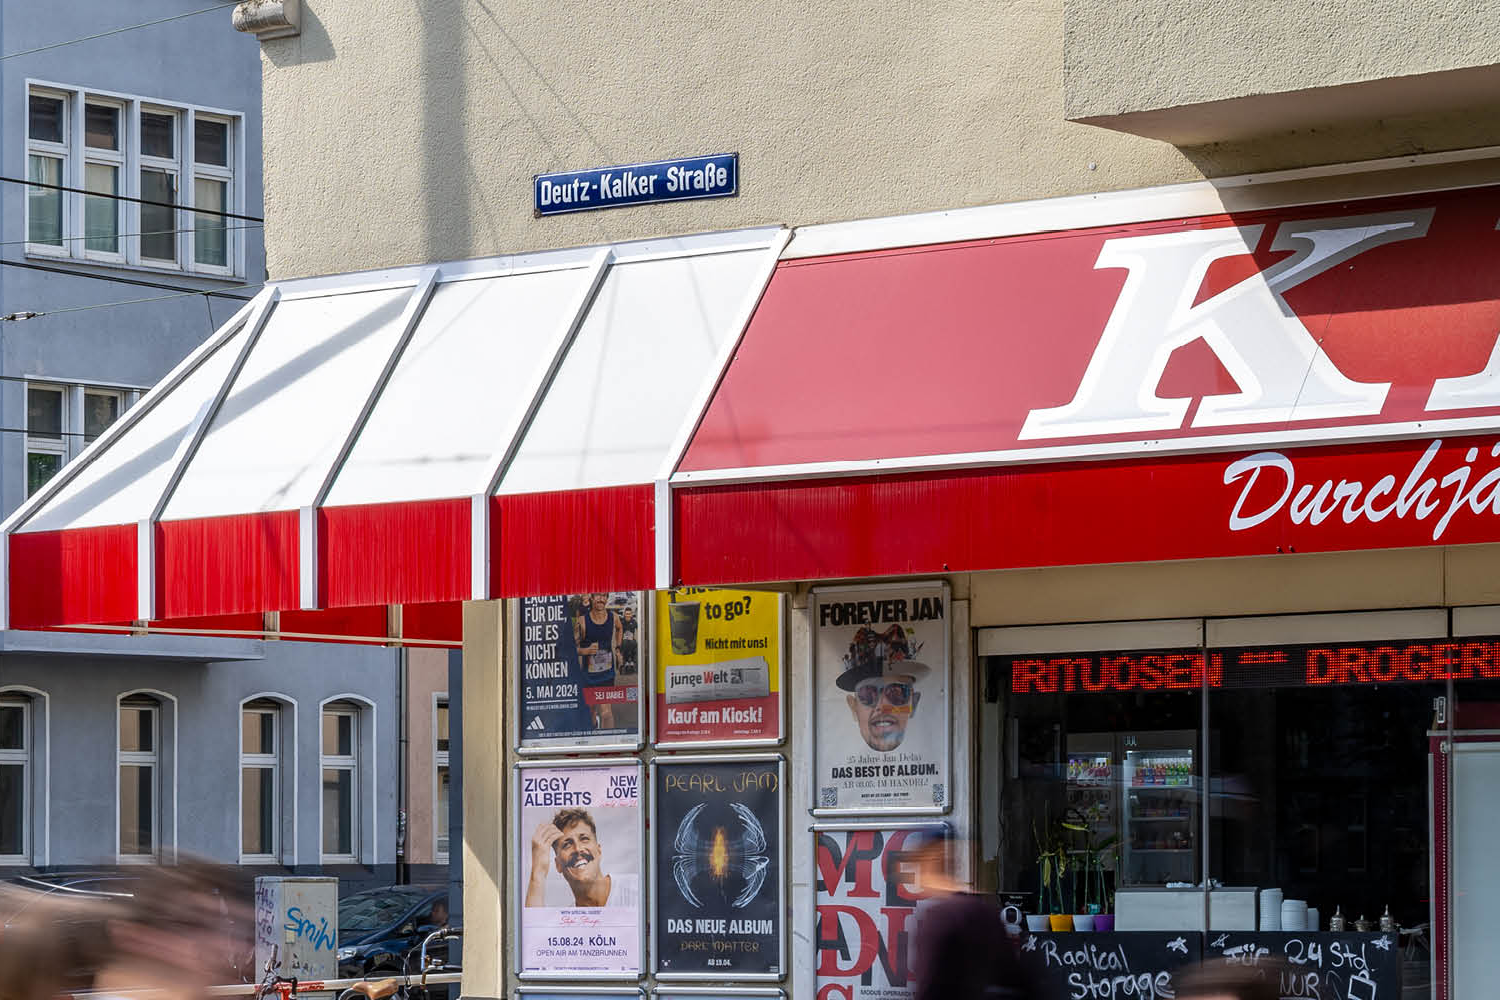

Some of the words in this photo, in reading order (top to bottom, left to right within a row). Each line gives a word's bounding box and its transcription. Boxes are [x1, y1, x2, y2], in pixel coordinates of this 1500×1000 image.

[540, 172, 658, 206] Deutz-Kalker
[666, 162, 728, 193] Straße
[1017, 206, 1500, 441] K
[524, 604, 546, 623] FÜR
[547, 605, 568, 623] DIE,
[705, 602, 721, 620] to
[724, 596, 752, 621] go?
[819, 599, 908, 627] FOREVER
[909, 597, 944, 620] JAN
[525, 626, 543, 642] DIE
[545, 624, 559, 640] ES
[705, 638, 729, 649] Nicht
[730, 638, 746, 649] mit
[747, 636, 768, 649] uns!
[525, 643, 557, 661] NICHT
[525, 660, 569, 680] KÖNNEN
[526, 686, 535, 699] 5.
[536, 685, 554, 698] MAI
[555, 684, 578, 698] 2024
[667, 707, 699, 724] Kauf
[699, 710, 720, 724] am
[722, 706, 763, 723] Kiosk!
[831, 766, 853, 779] DAS
[854, 765, 881, 778] BEST
[882, 764, 896, 777] OF
[897, 763, 939, 776] ALBUM.
[524, 777, 570, 793] ZIGGY
[609, 775, 638, 787] NEW
[664, 773, 726, 793] PEARL
[732, 771, 779, 793] JAM
[524, 791, 592, 807] ALBERTS
[606, 787, 638, 799] LOVE
[667, 918, 693, 934] DAS
[695, 919, 727, 934] NEUE
[729, 919, 773, 935] ALBUM
[547, 936, 584, 947] 15.08.24
[588, 934, 616, 947] KÖLN
[536, 949, 555, 957] OPEN
[579, 949, 628, 957] TANZBRUNNEN
[1041, 939, 1131, 973] Radical
[1284, 938, 1324, 969] 24
[1279, 969, 1321, 1000] NUR
